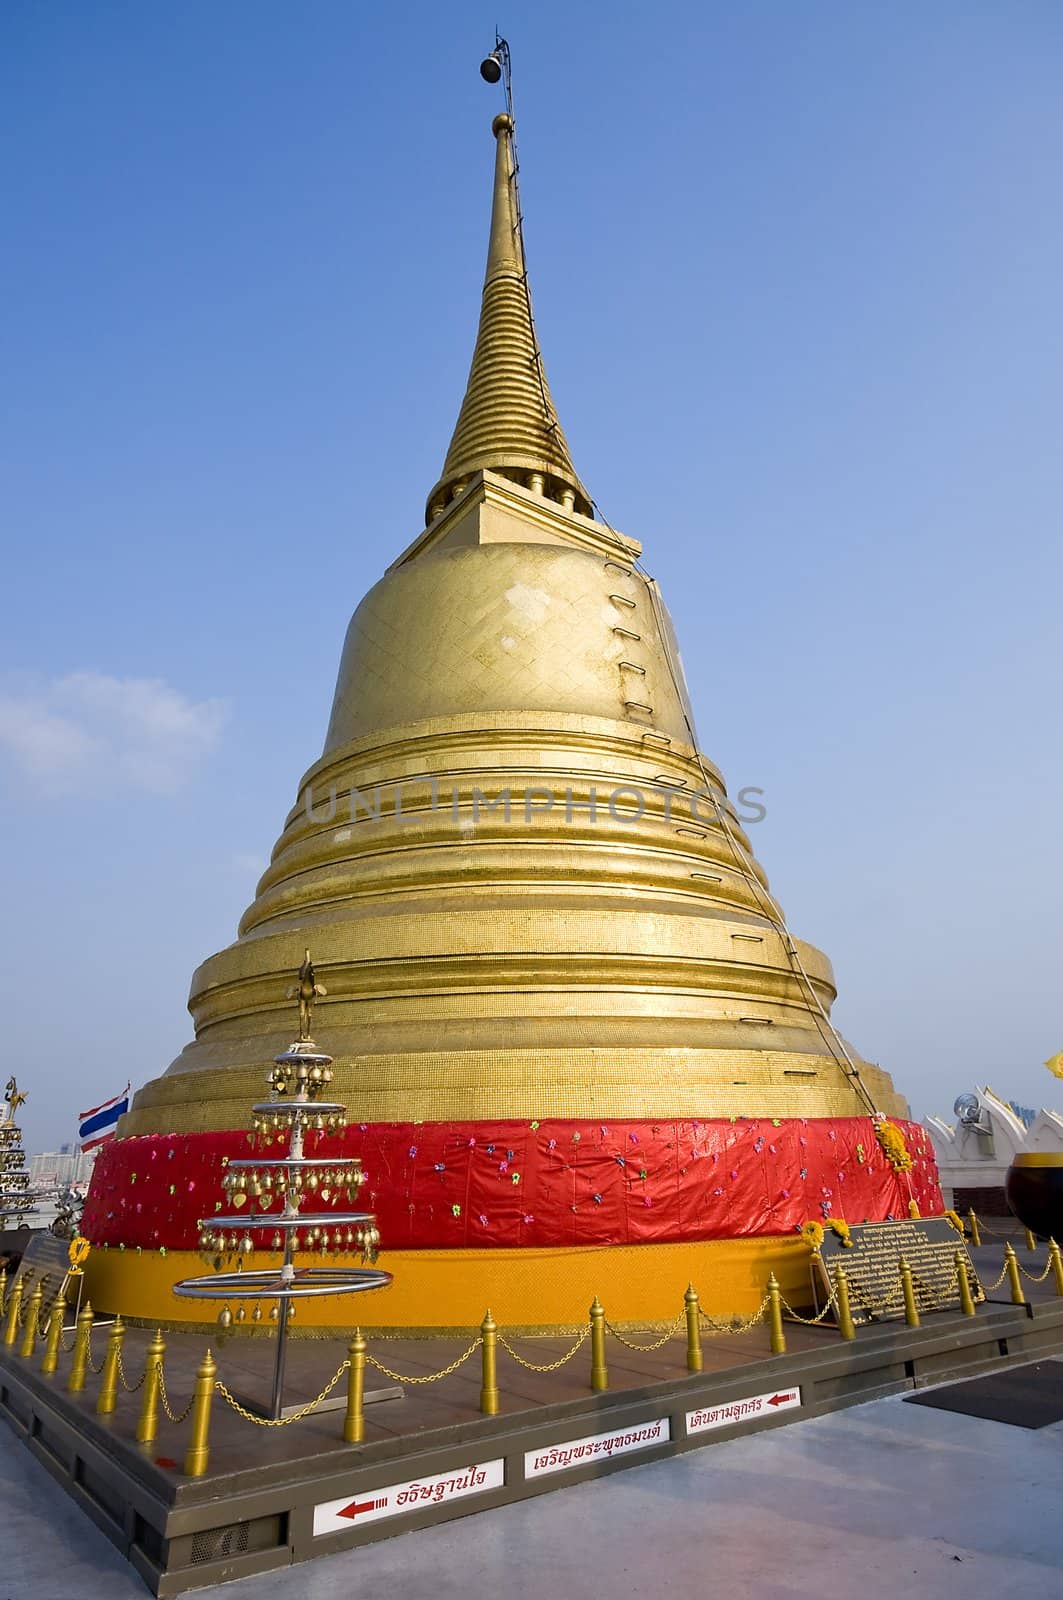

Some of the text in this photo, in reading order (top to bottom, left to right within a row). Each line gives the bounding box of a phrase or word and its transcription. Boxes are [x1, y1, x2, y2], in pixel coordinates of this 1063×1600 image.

[533, 1419, 661, 1470] เจริญพระพุทธมนต์
[396, 1464, 487, 1505] อธิษฐานใจ
